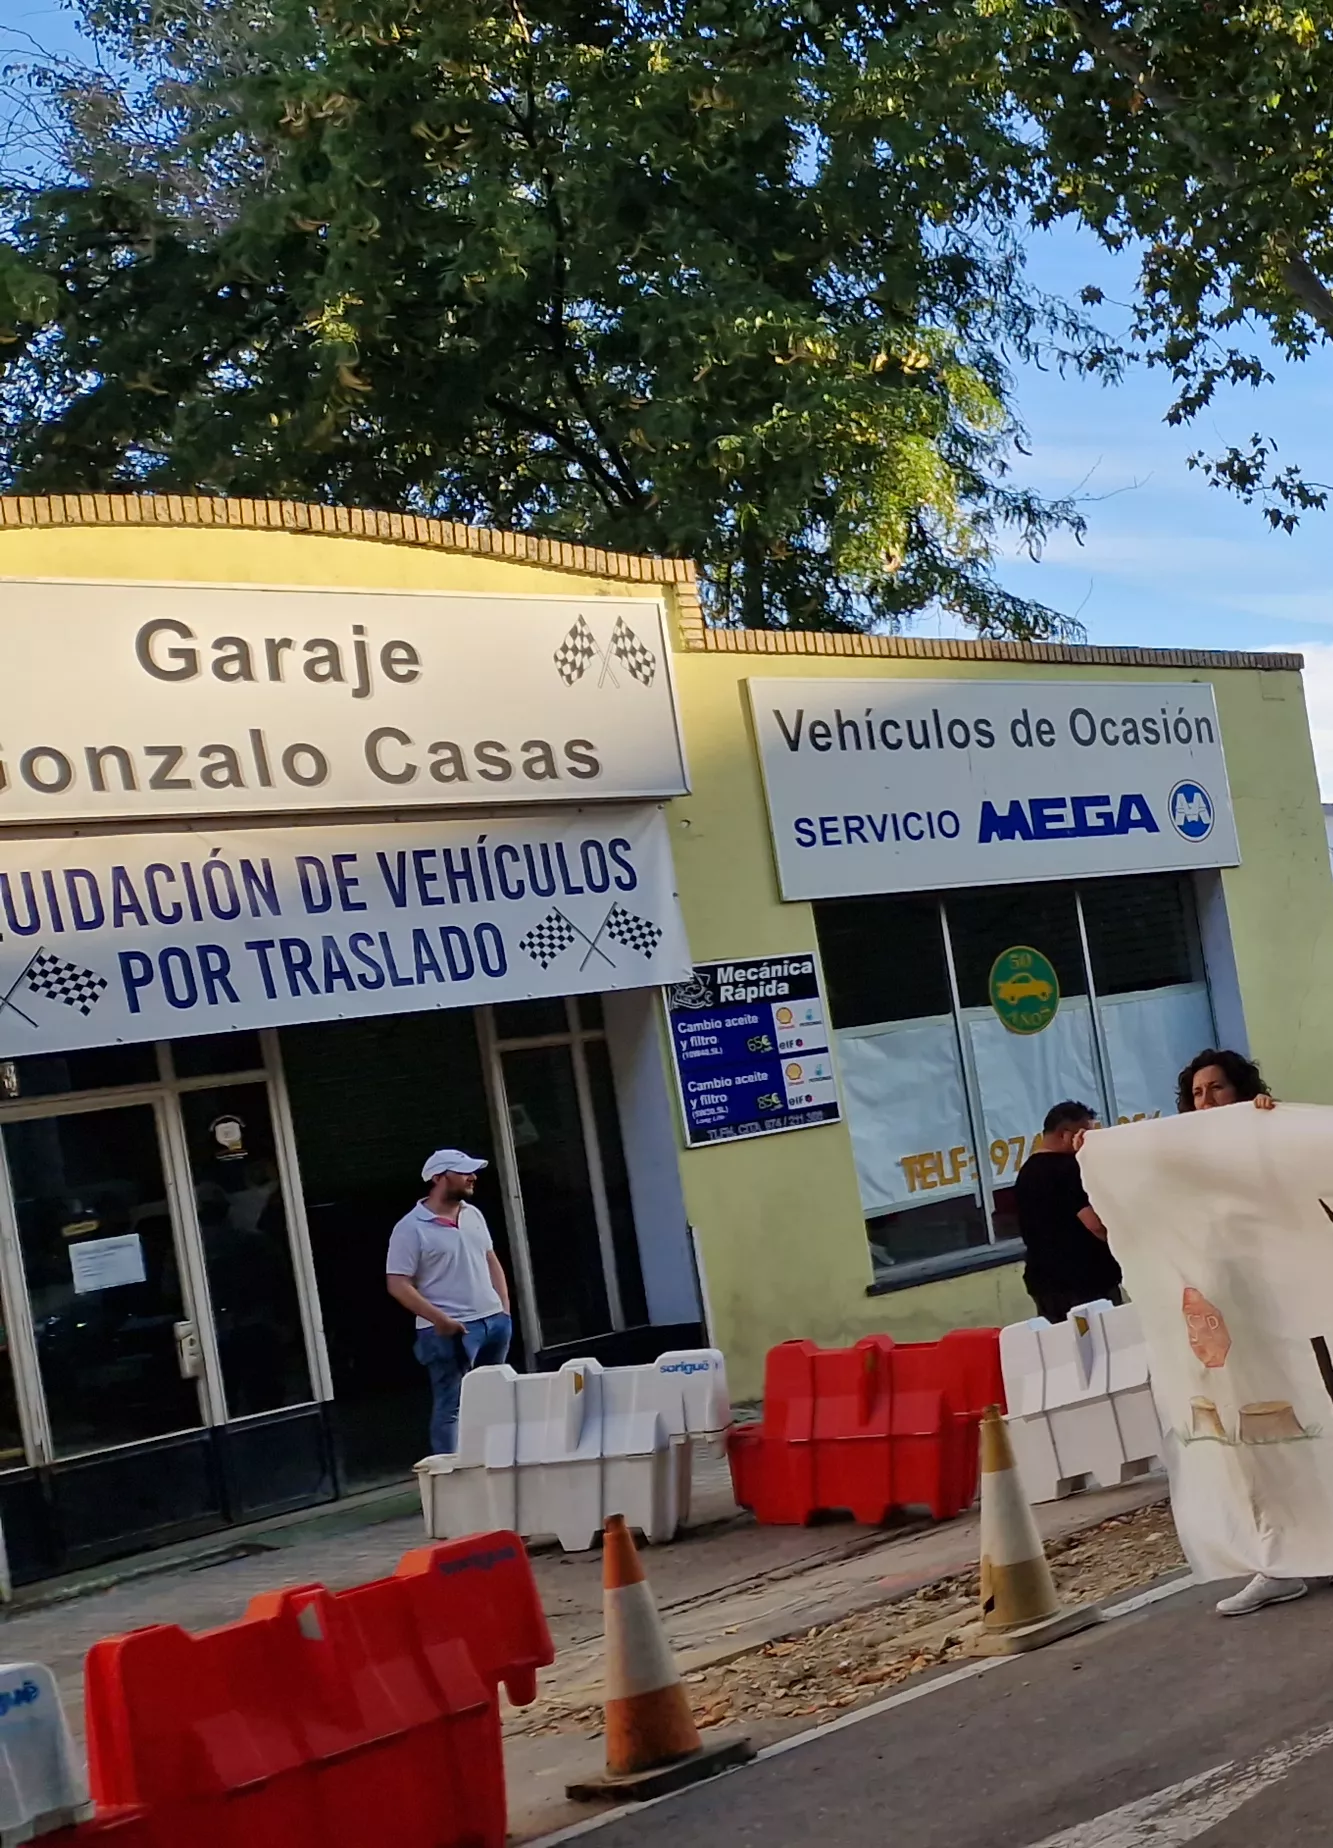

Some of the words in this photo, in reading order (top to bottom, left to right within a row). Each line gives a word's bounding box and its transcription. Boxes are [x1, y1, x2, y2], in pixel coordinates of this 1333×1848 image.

[135, 617, 422, 700] Garaje
[773, 708, 996, 753] Vehículos
[1010, 707, 1057, 750] de
[1069, 705, 1216, 748] Ocasión
[0, 728, 330, 794] onzalo
[363, 726, 602, 786] Casas
[794, 809, 961, 849] SERVICIO
[978, 794, 1160, 843] MEGA
[0, 847, 282, 942] UIDACIÓN
[295, 853, 368, 915] DE
[376, 834, 638, 909] VEHÍCULOS
[117, 943, 242, 1014] POR
[245, 921, 509, 1000] TRASLADO
[716, 960, 813, 985] Mecánica
[720, 980, 790, 1003] Rápida
[677, 1016, 722, 1034] Cambio
[725, 1014, 759, 1029] aceite
[680, 1039, 688, 1051] y
[690, 1035, 718, 1047] filtro
[687, 1074, 732, 1092] Cambio
[735, 1071, 769, 1087] aceite
[690, 1097, 698, 1109] y
[700, 1093, 728, 1105] filtro
